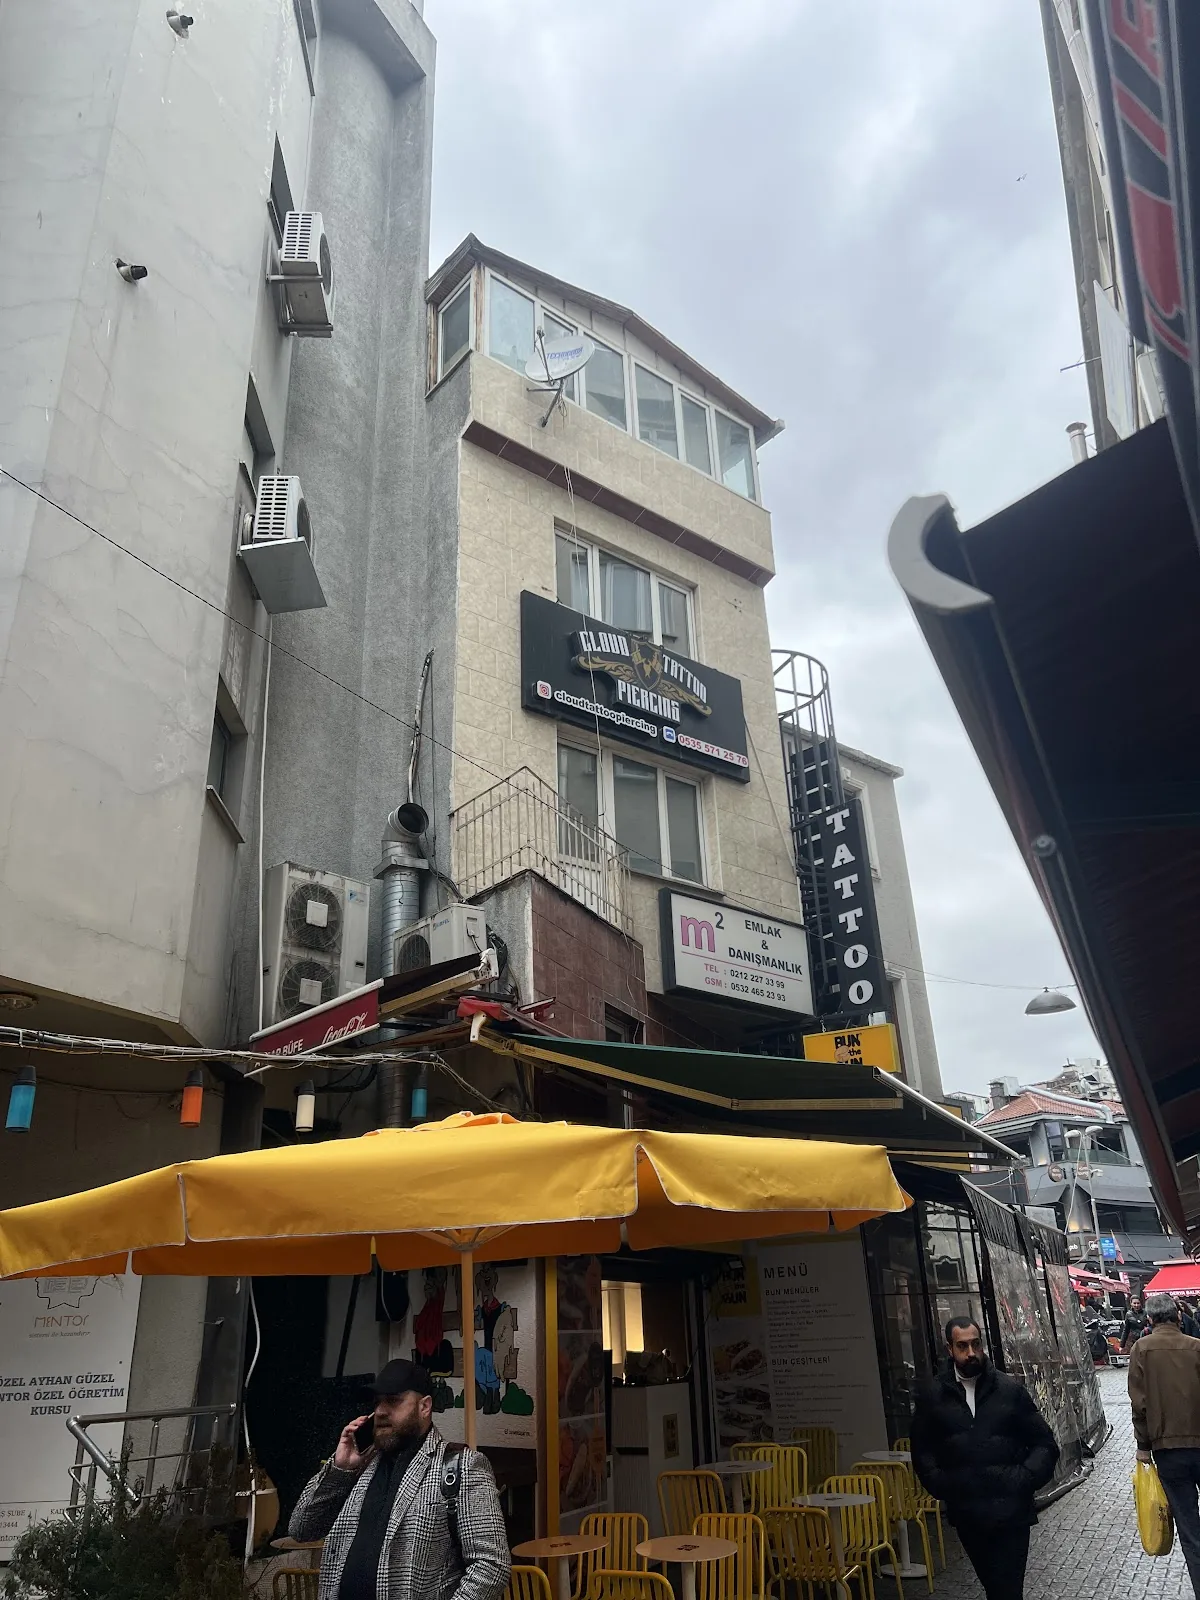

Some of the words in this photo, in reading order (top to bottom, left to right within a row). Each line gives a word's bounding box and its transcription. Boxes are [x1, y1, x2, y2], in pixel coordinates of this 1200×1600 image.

[578, 630, 630, 656] CLOUD
[662, 653, 707, 703] TATTOO
[618, 679, 680, 722] PIERCING
[556, 690, 656, 735] cloudtattoopiercing
[679, 734, 702, 752] 0535
[704, 742, 720, 758] 571
[723, 749, 734, 763] 25
[736, 754, 748, 766] 76
[826, 808, 874, 1005] TATTOO
[745, 919, 782, 939] EMLAK
[761, 940, 769, 950] &
[728, 947, 803, 976] DANIŞMANLIK
[704, 963, 720, 974] TEL
[730, 969, 748, 982] 0212
[750, 973, 764, 984] 227
[766, 976, 775, 988] 33
[776, 978, 786, 990] 99
[730, 982, 750, 994] 0532
[751, 986, 766, 998] 465
[766, 989, 776, 1000] 23
[776, 991, 786, 1002] 93
[282, 1038, 304, 1056] BÜFE
[848, 1048, 862, 1056] the
[764, 1262, 808, 1279] MENÜ
[28, 1375, 73, 1386] AYHAN
[76, 1372, 115, 1384] GÜZEL
[34, 1388, 64, 1401] ÖZEL
[68, 1386, 125, 1400] ÖĞRETİM
[30, 1405, 72, 1416] KURSU
